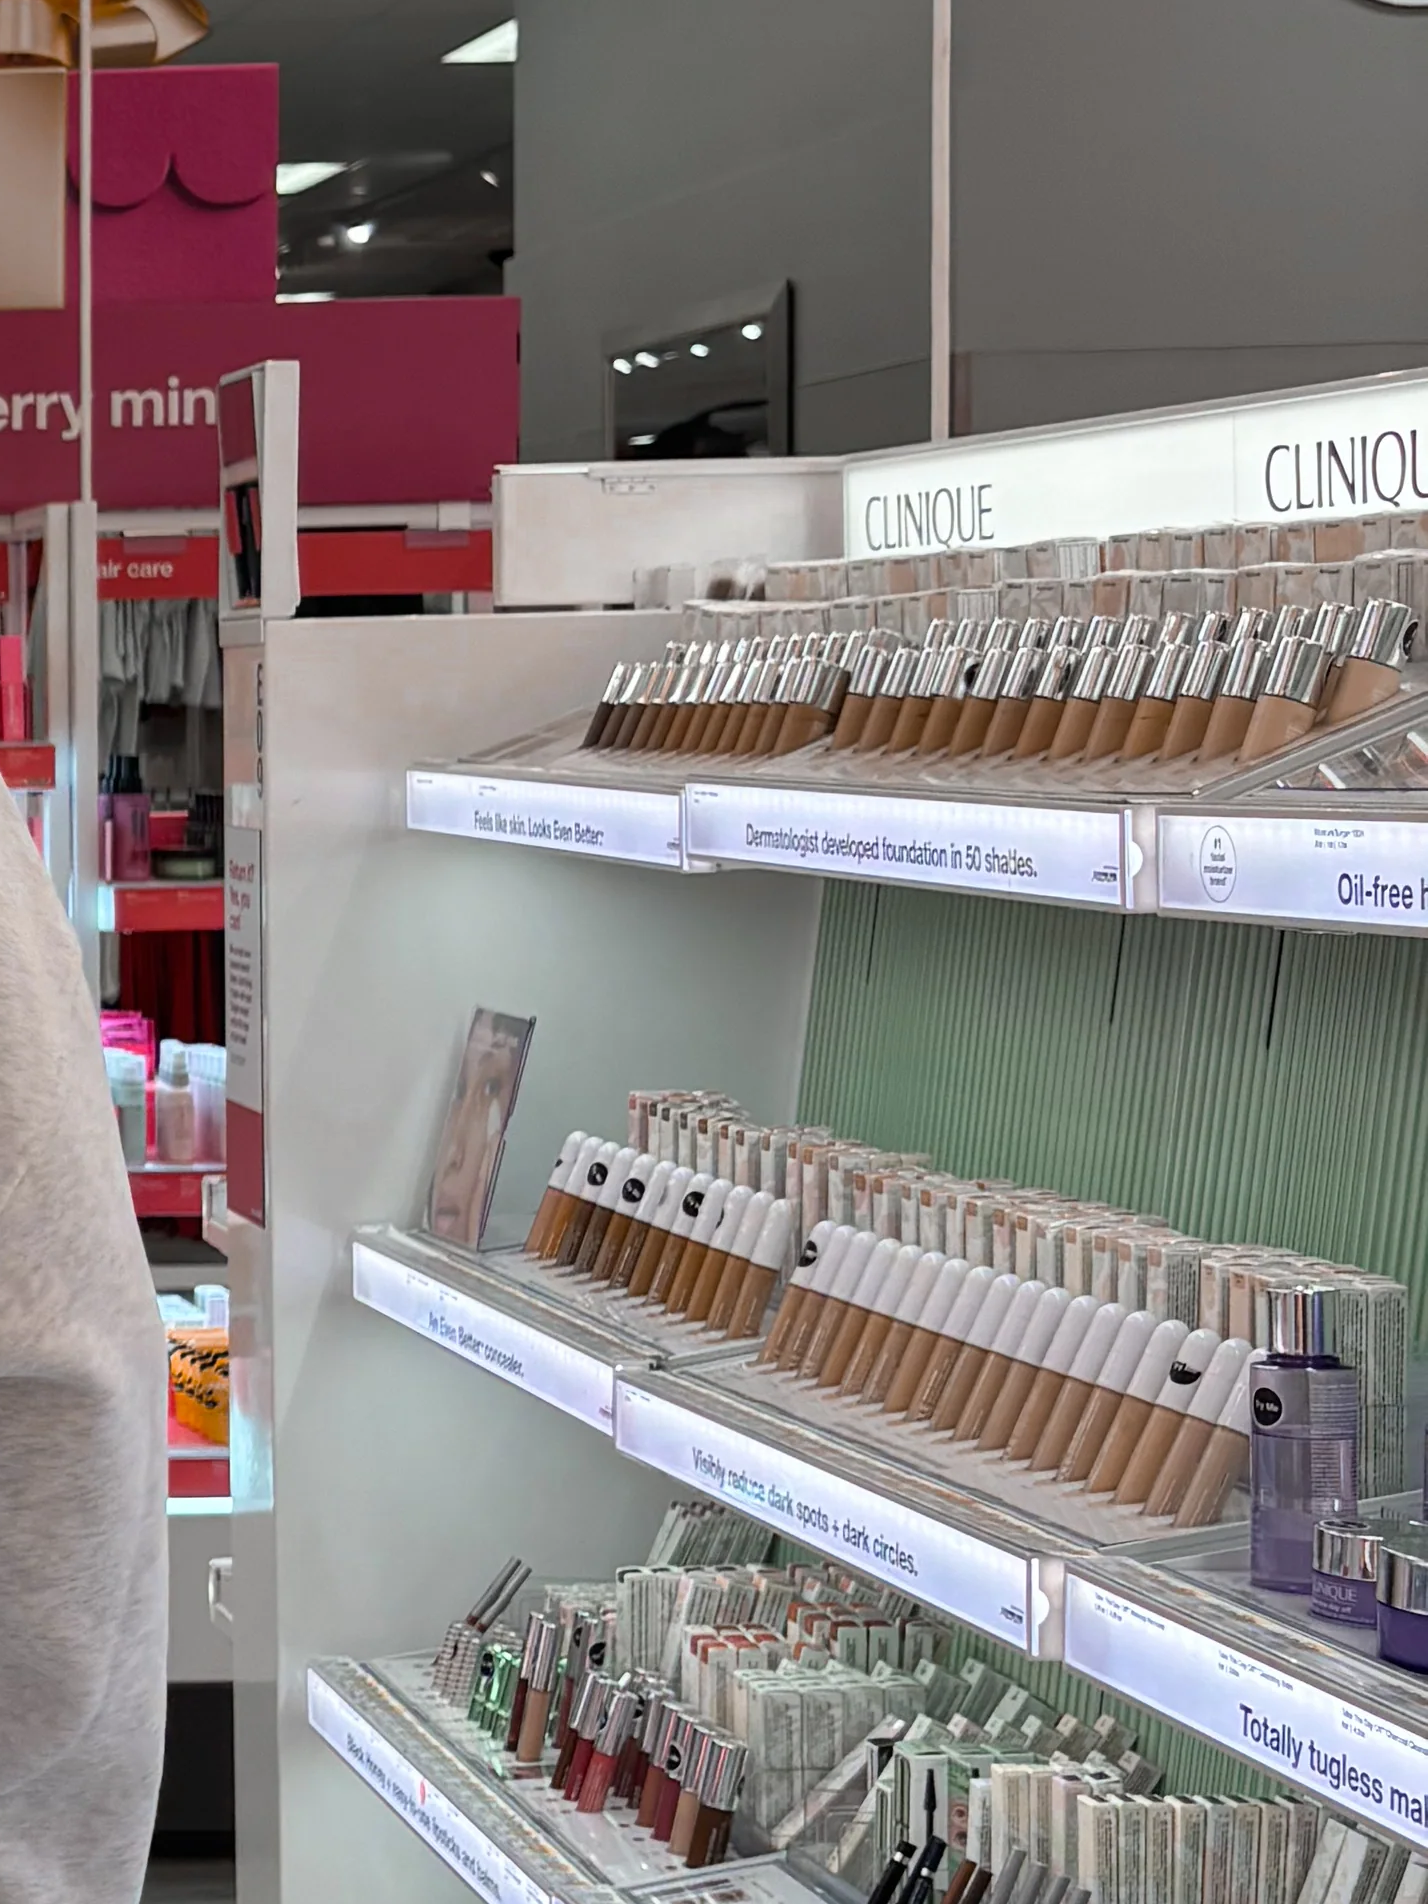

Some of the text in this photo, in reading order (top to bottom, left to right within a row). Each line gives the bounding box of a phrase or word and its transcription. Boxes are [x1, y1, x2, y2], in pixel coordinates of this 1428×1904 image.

[865, 483, 994, 551] CLINIQUE
[127, 561, 173, 578] care
[474, 811, 572, 841] Feels like skin. Looks Even
[746, 823, 1037, 878] Dermatologist developed foundation in 50 shades.
[1337, 873, 1414, 910] Oil-free
[440, 1317, 456, 1342] Even
[692, 1446, 918, 1576] Visibly reduce dark spots + dark circles.
[1239, 1702, 1303, 1768] Totally
[1308, 1739, 1384, 1804] tugless
